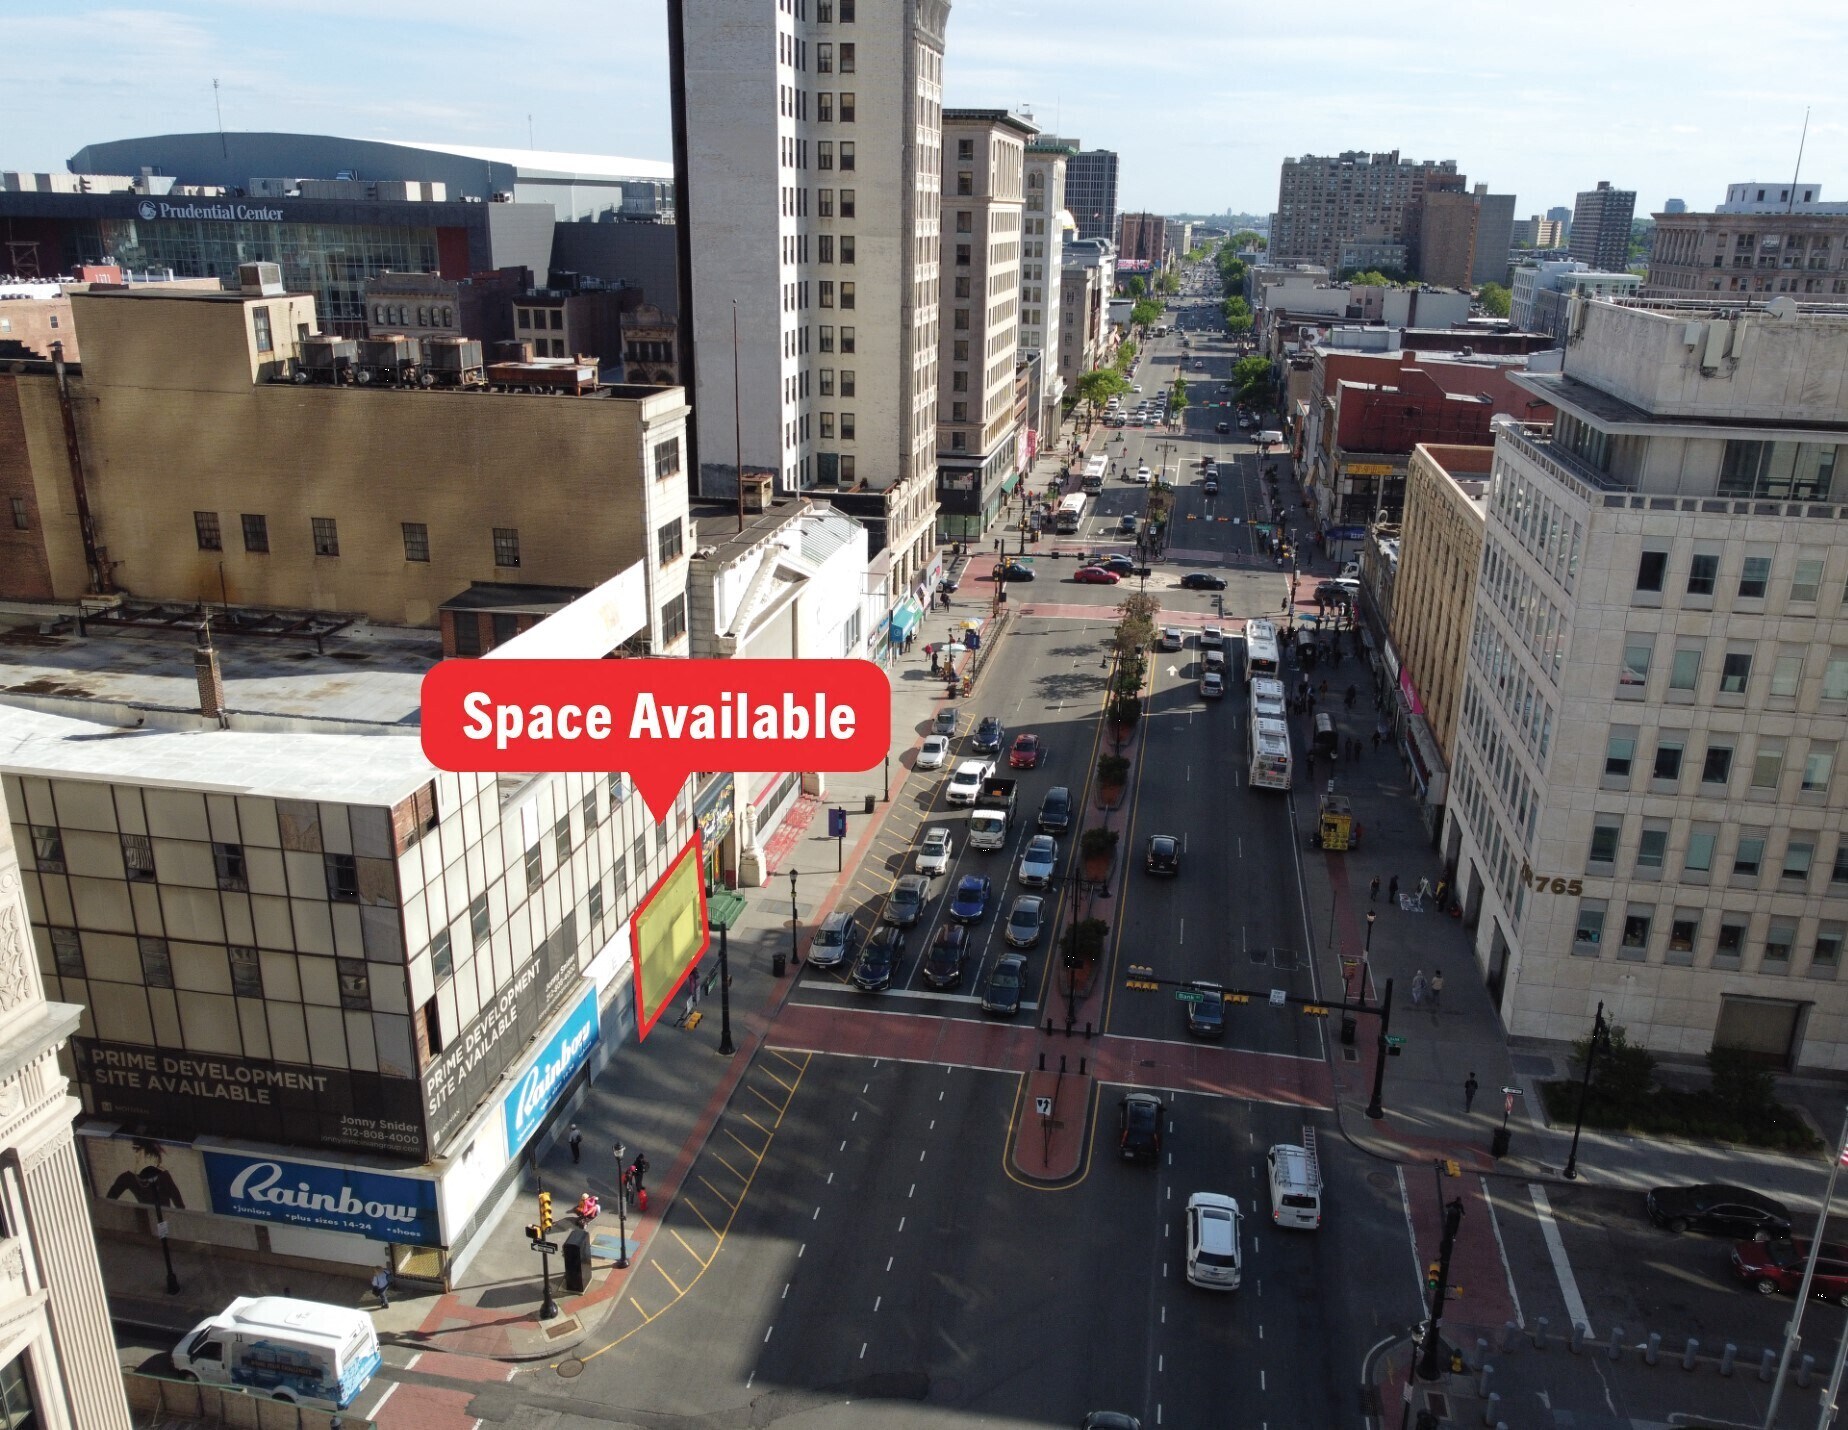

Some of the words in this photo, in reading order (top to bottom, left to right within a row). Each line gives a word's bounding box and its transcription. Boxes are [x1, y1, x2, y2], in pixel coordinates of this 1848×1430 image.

[159, 202, 235, 220] Prudential
[237, 204, 283, 221] Center
[1535, 876, 1583, 896] 765
[426, 1045, 464, 1097] PRIME
[465, 958, 541, 1052] DEVELOPMENT
[91, 1049, 158, 1072] PRIME
[163, 1058, 328, 1092] DEVELOPMENT
[429, 1082, 456, 1117] SITE
[458, 1004, 518, 1084] AVAILABLE
[515, 1019, 591, 1131] Rainbow
[96, 1068, 142, 1088] SITE
[147, 1076, 271, 1105] AVAILABLE
[340, 1115, 376, 1130] Jonny
[380, 1119, 418, 1132] Snider
[342, 1127, 419, 1144] 212-808-4000
[229, 1162, 417, 1223] Rainbow
[290, 1213, 312, 1222] plus
[314, 1216, 339, 1226] sizes
[342, 1220, 372, 1230] 14-24
[392, 1227, 421, 1237] shoes
[235, 1333, 243, 1343] 11
